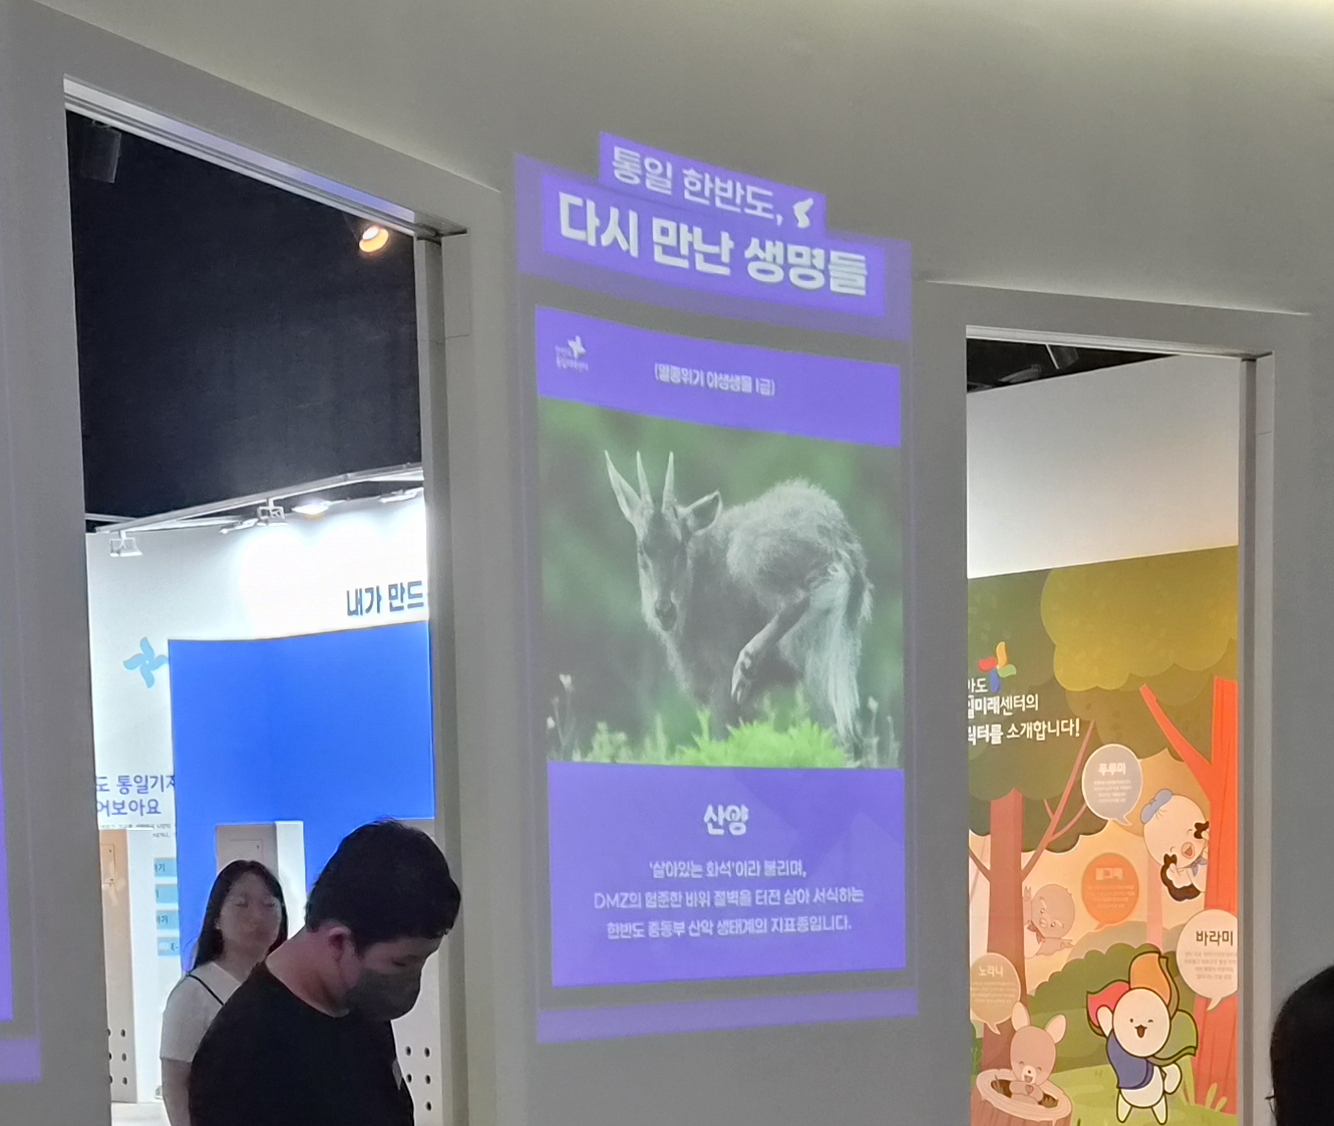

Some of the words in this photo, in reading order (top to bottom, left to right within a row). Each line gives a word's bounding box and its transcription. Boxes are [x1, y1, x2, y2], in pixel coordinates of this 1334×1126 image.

[612, 146, 672, 195] 통일
[682, 167, 783, 227] 한반도,
[559, 192, 638, 258] 다시
[652, 217, 734, 276] 만난
[744, 237, 867, 296] 생명들
[706, 370, 752, 394] 야생생물
[346, 585, 382, 616] 내가
[388, 580, 424, 612] 만드
[1006, 717, 1080, 741] 소개합니다!
[703, 804, 749, 836] 산양
[594, 892, 641, 910] DMZ의
[685, 891, 710, 908] 바위
[755, 888, 781, 906] 터전
[784, 887, 810, 905] 삼아
[813, 886, 865, 904] 서식하는
[607, 921, 645, 939] 한반도
[688, 919, 713, 937] 산악
[716, 917, 767, 936] 생태계의
[771, 915, 852, 934] 지표종입니다.
[1196, 930, 1233, 946] 바라미
